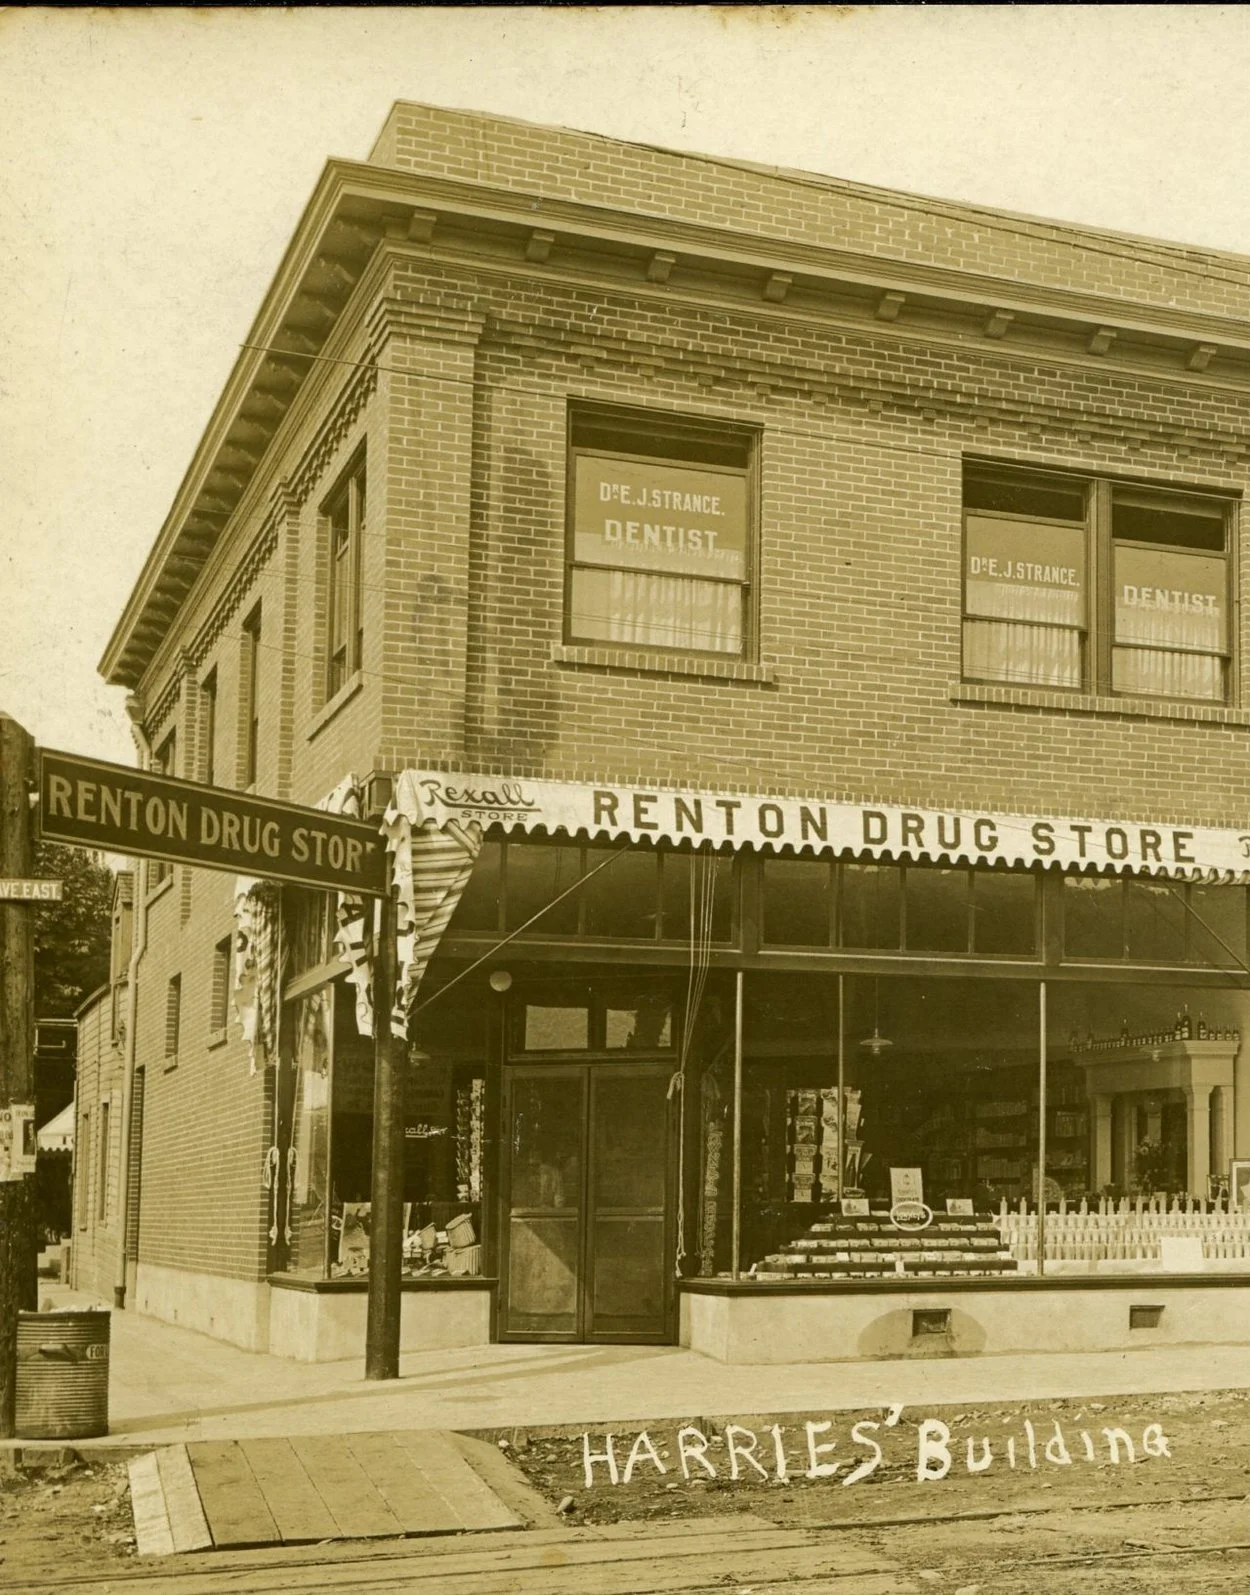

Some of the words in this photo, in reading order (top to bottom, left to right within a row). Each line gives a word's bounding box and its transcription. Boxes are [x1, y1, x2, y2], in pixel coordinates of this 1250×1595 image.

[604, 518, 718, 552] DENTIST
[419, 780, 542, 813] Rexall
[48, 773, 189, 841] RENTON
[199, 806, 281, 858] DRUG
[460, 809, 529, 822] STORE
[592, 789, 829, 842] RENTON
[861, 810, 999, 852] DRUG
[1031, 822, 1196, 864] STORE
